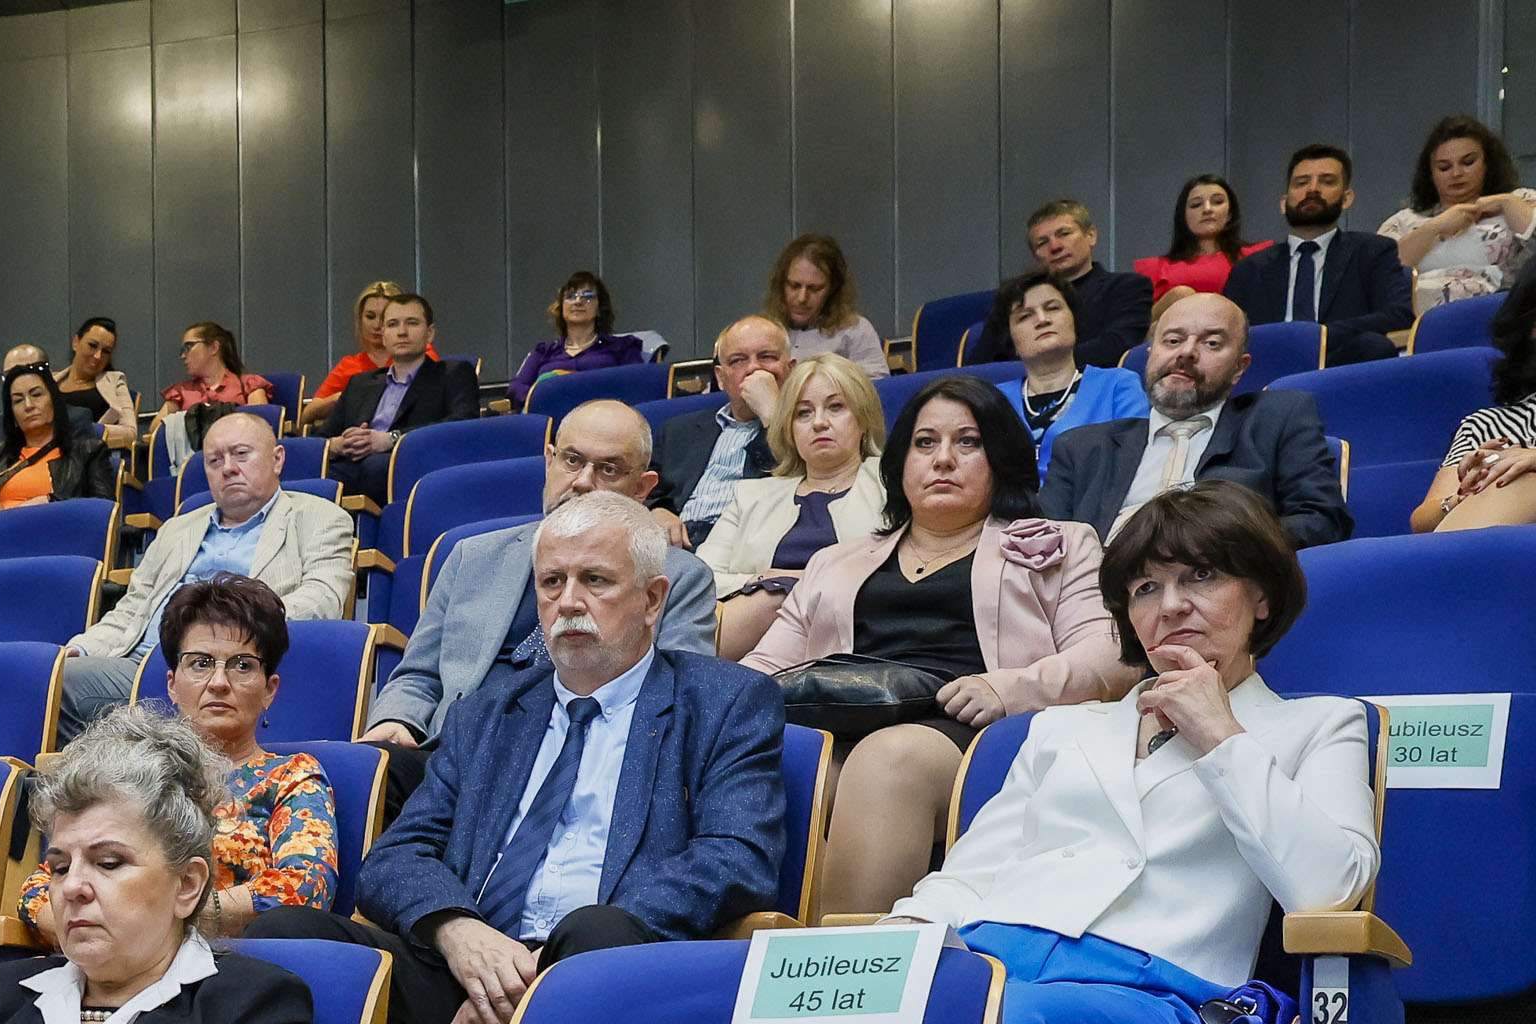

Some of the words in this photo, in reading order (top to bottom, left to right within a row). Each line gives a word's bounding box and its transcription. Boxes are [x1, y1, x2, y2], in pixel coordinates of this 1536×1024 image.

[1389, 721, 1484, 737] ubileusz
[1394, 746, 1422, 763] 30
[1430, 746, 1458, 763] lat
[770, 955, 902, 979] Jubileusz
[789, 990, 823, 1012] 45
[831, 988, 866, 1010] lat
